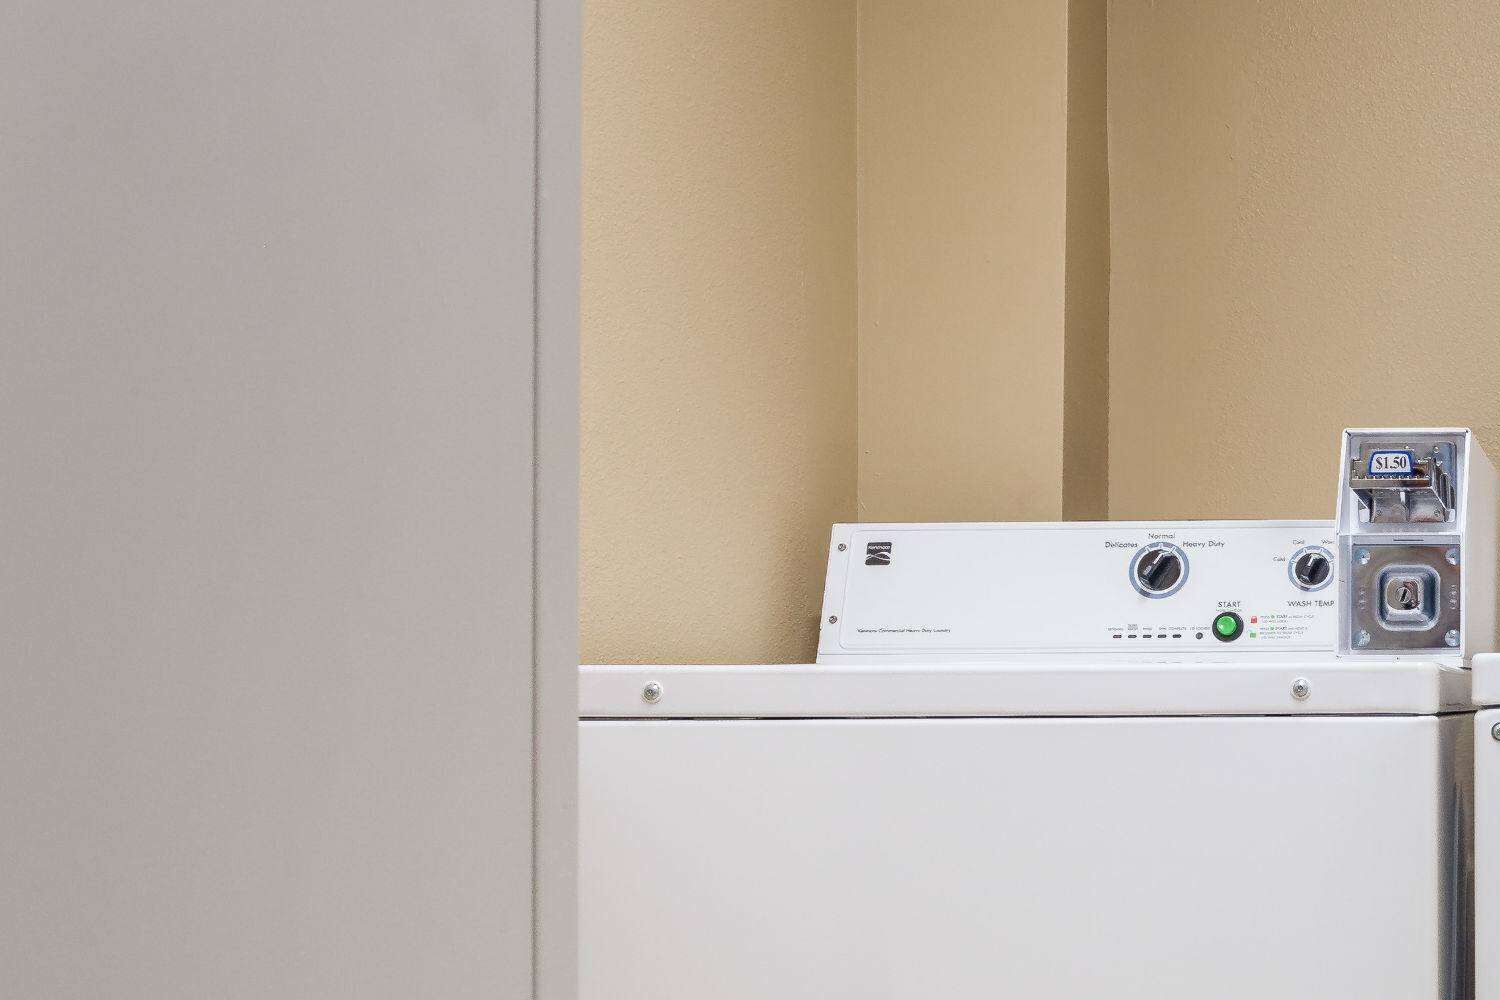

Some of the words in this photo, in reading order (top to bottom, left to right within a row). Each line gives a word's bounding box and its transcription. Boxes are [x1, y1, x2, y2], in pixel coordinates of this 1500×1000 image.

[1375, 456, 1407, 471] $1.50
[1182, 540, 1206, 548] Heavy
[1208, 540, 1225, 548] Duty
